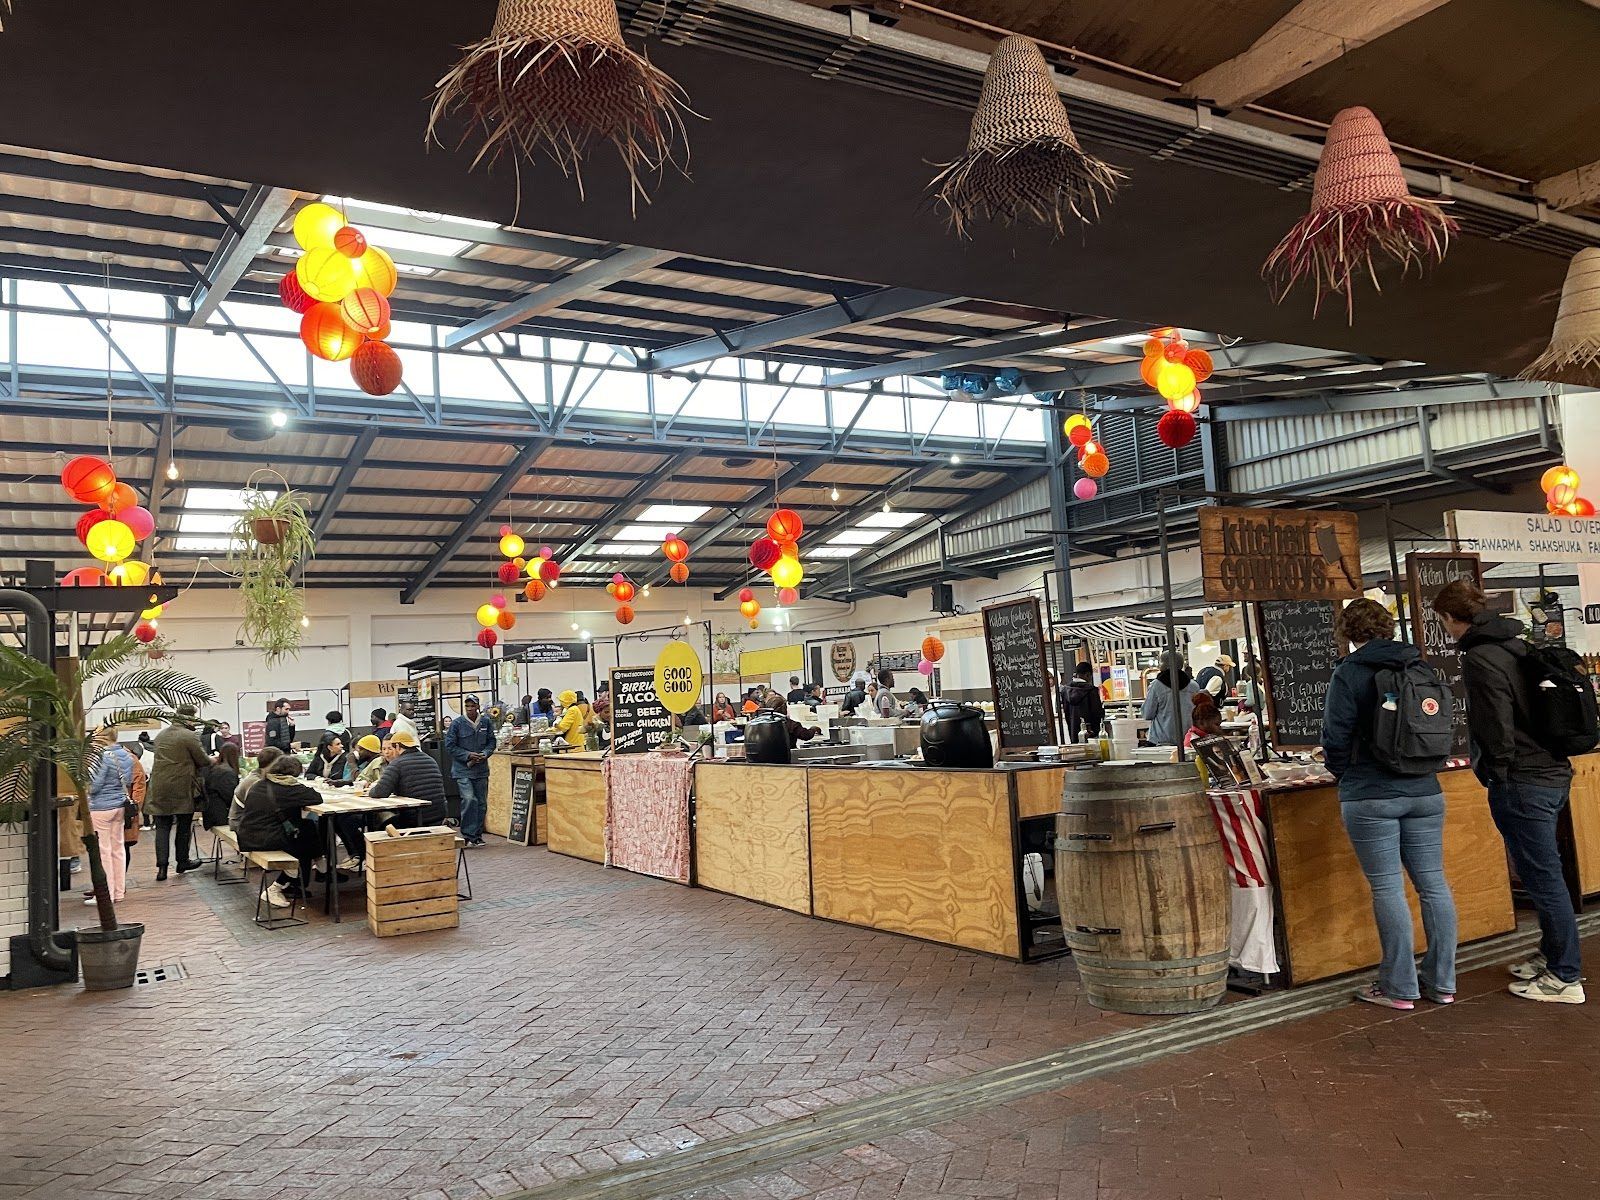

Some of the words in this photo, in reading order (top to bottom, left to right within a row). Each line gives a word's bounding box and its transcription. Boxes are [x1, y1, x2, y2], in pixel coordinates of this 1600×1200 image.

[1527, 517, 1562, 533] SALAD
[1468, 538, 1523, 552] SHAWARMA
[1530, 540, 1582, 553] SHAKSHUKA
[664, 667, 692, 680] GOOD
[664, 680, 693, 693] GOOD
[637, 707, 662, 717] BEEF
[637, 715, 671, 728] CHICKEN
